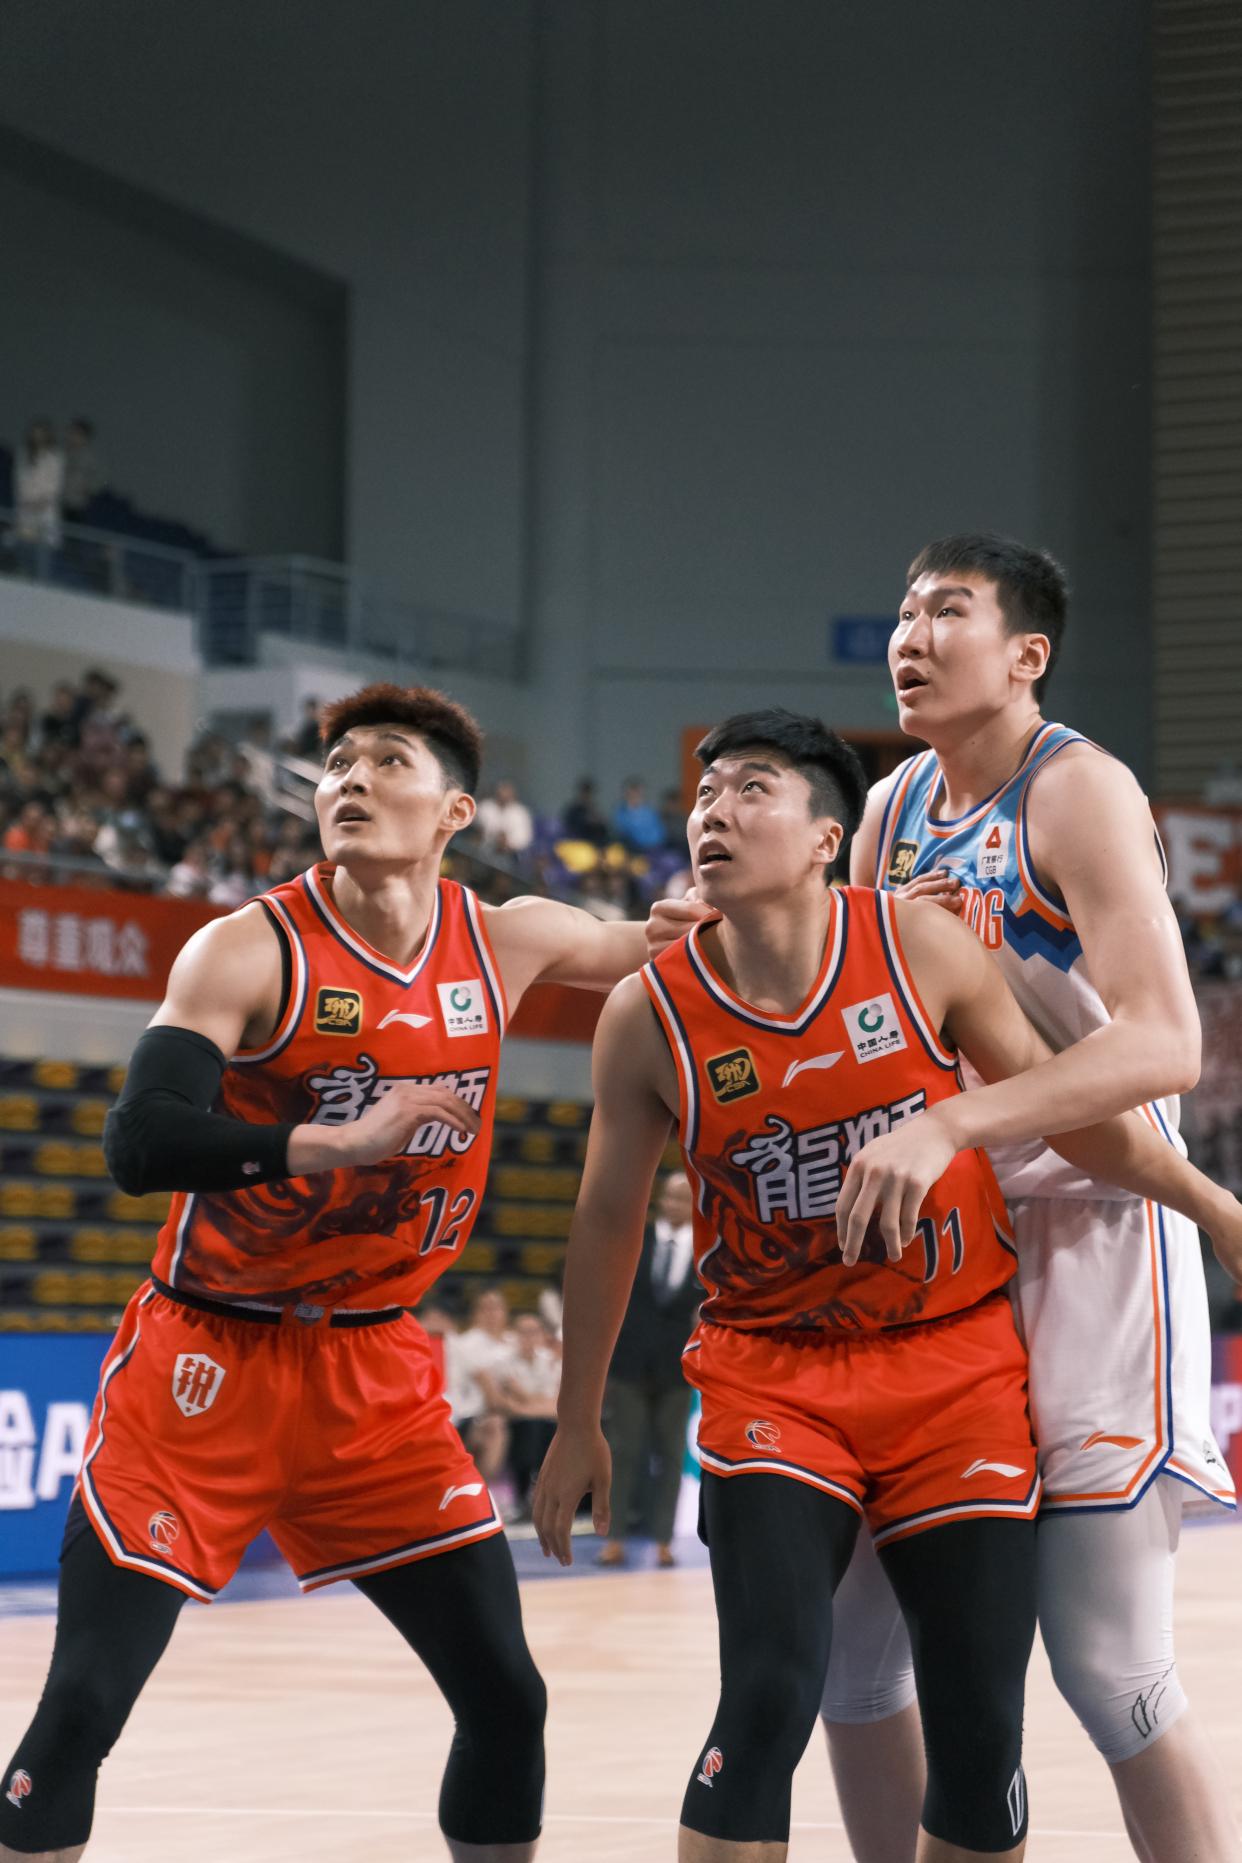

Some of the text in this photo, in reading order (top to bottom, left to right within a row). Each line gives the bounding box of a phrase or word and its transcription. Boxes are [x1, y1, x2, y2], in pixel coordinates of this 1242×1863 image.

[860, 1039, 900, 1058] CHINA LIFE
[419, 1186, 477, 1257] 12
[914, 1206, 965, 1284] 11
